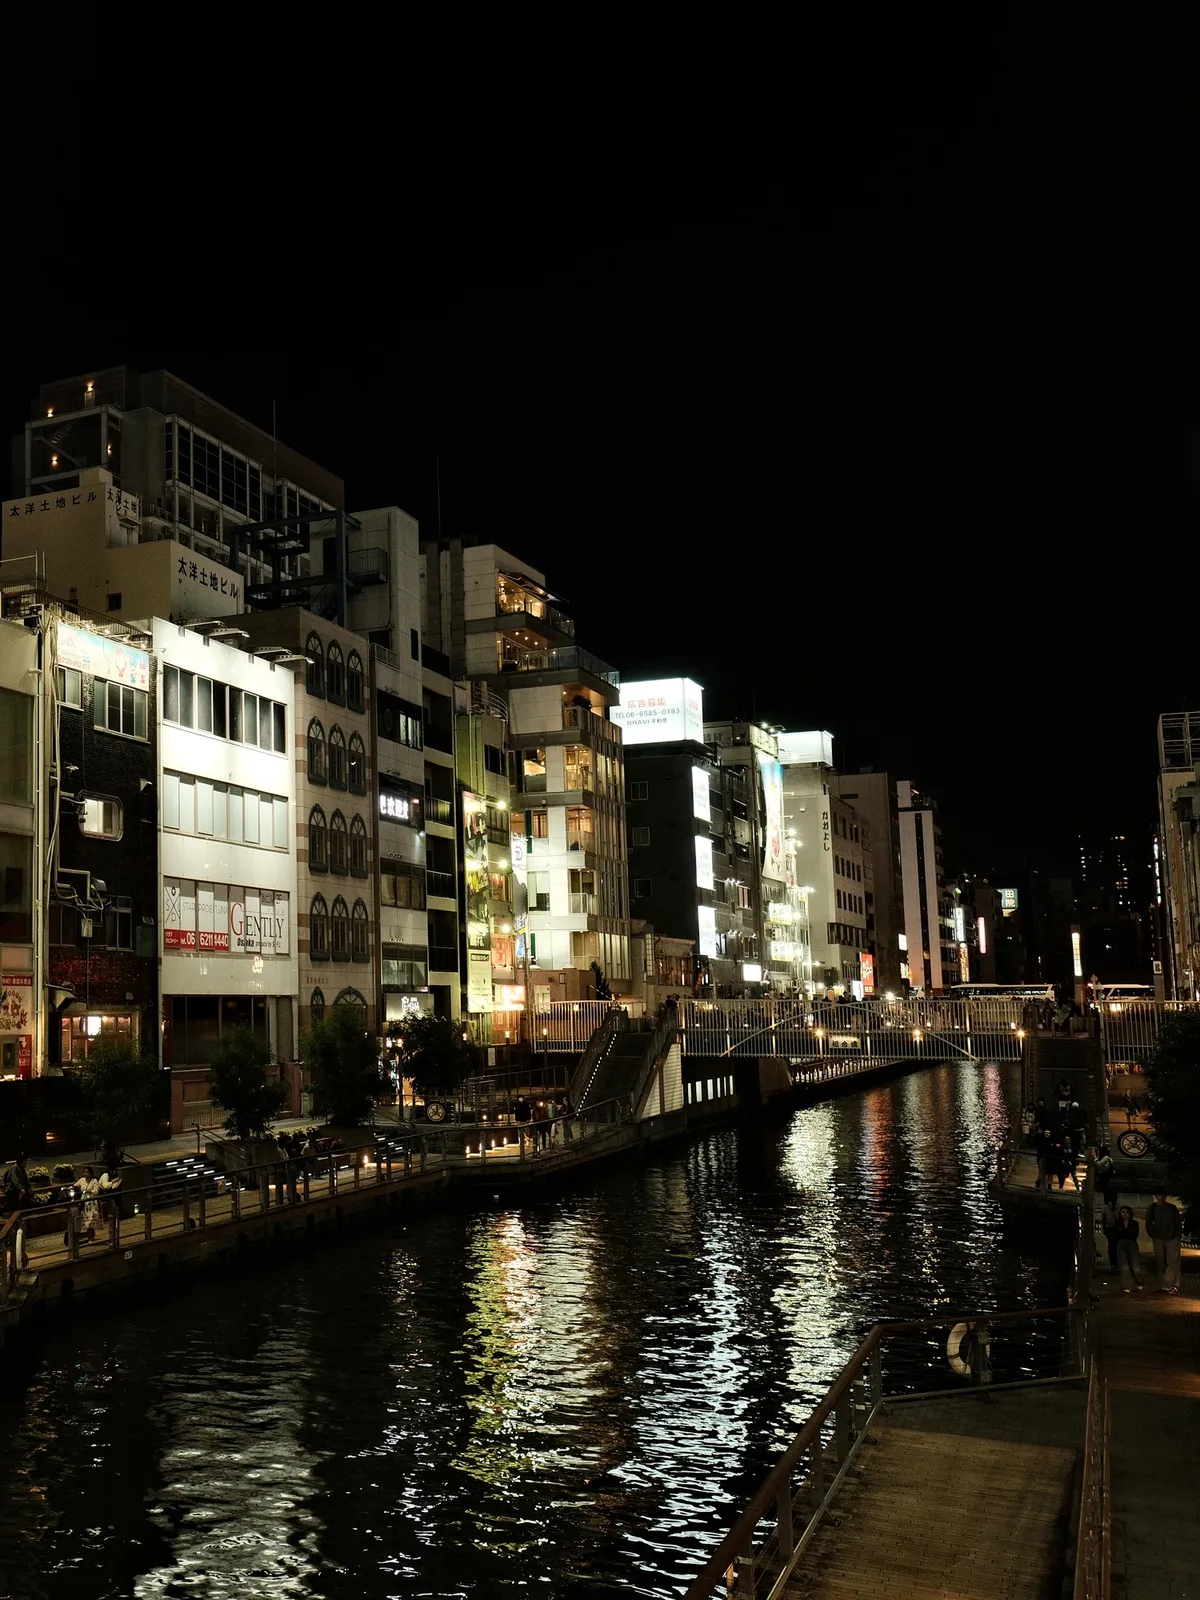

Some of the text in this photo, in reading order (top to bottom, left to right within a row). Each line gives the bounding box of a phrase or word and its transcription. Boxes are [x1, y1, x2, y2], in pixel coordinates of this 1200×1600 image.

[9, 491, 98, 518] 太洋土地ビル
[178, 556, 240, 599] 太洋土地ビル
[627, 697, 666, 709] 広告募集
[231, 902, 285, 938] GENTLY
